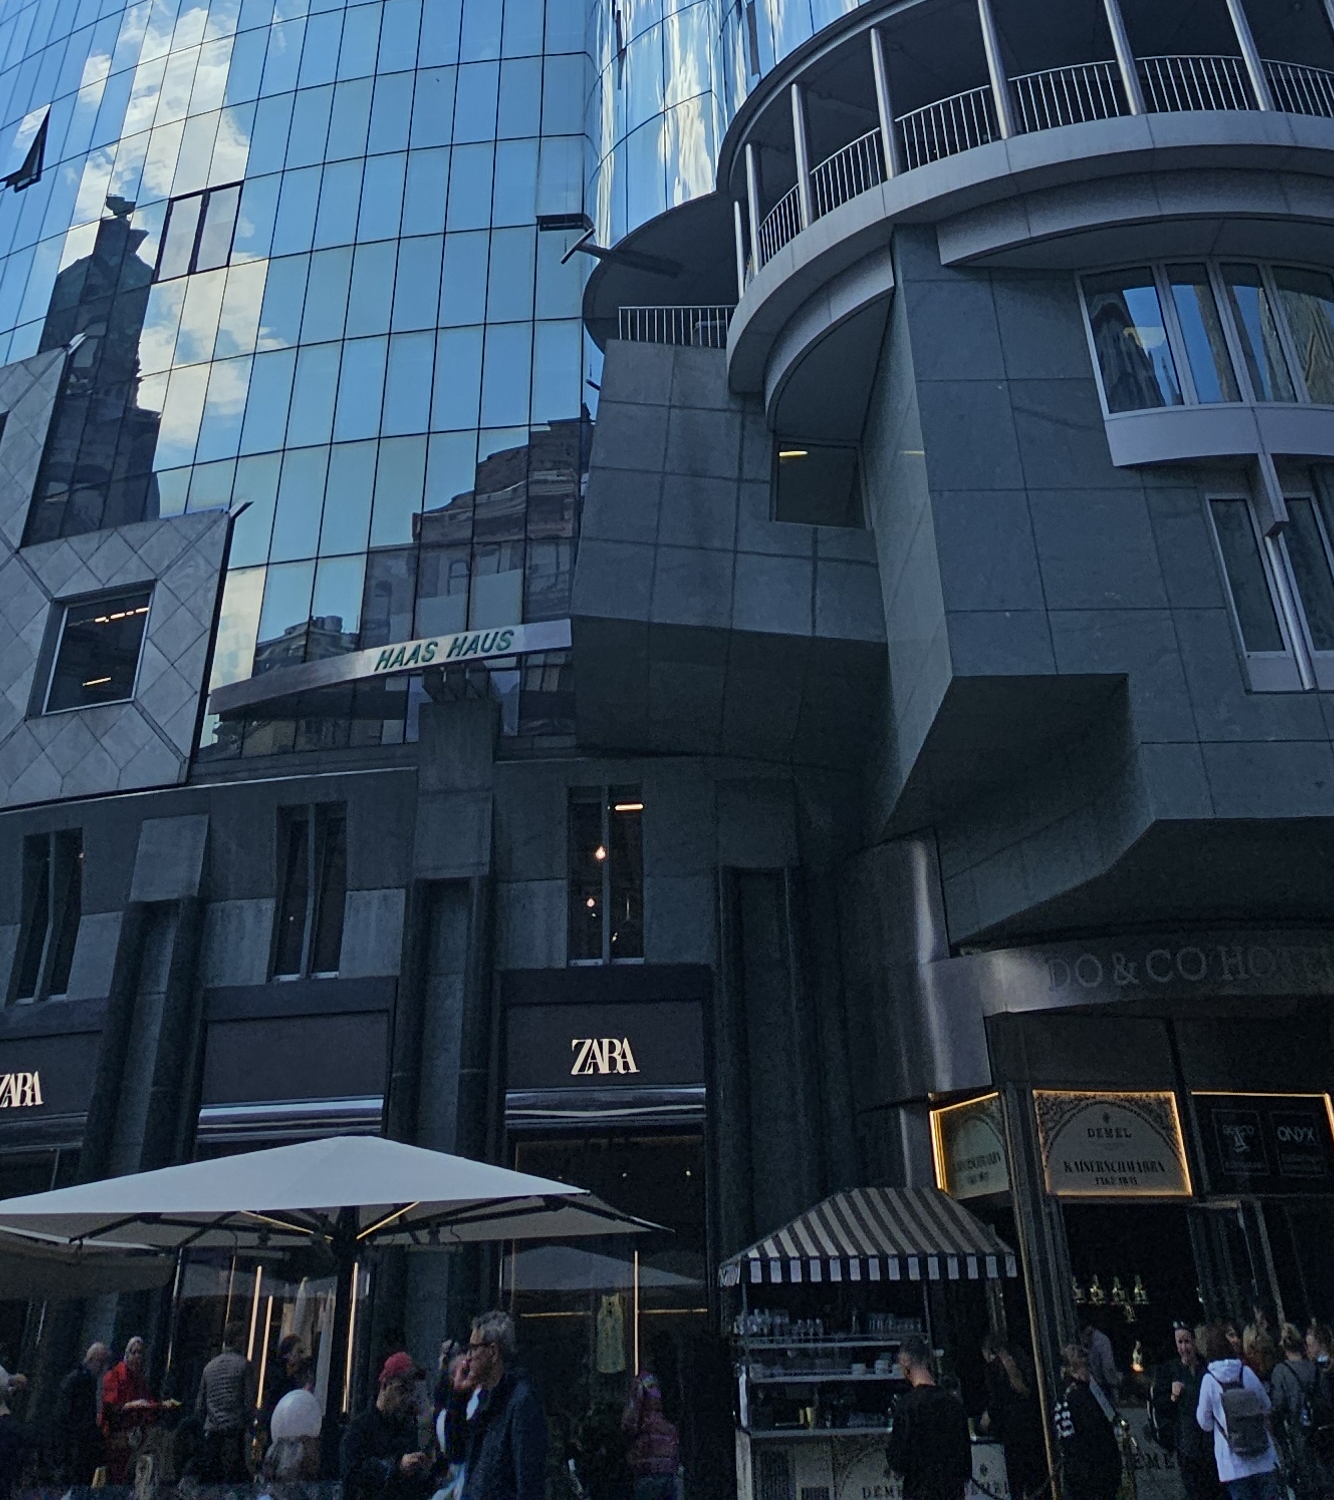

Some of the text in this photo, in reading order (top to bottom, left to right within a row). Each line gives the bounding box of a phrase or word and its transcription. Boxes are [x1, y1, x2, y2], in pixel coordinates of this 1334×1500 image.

[374, 629, 514, 672] HAAS HAUS
[571, 1037, 640, 1075] ZARA
[1087, 1128, 1132, 1138] DEMEL
